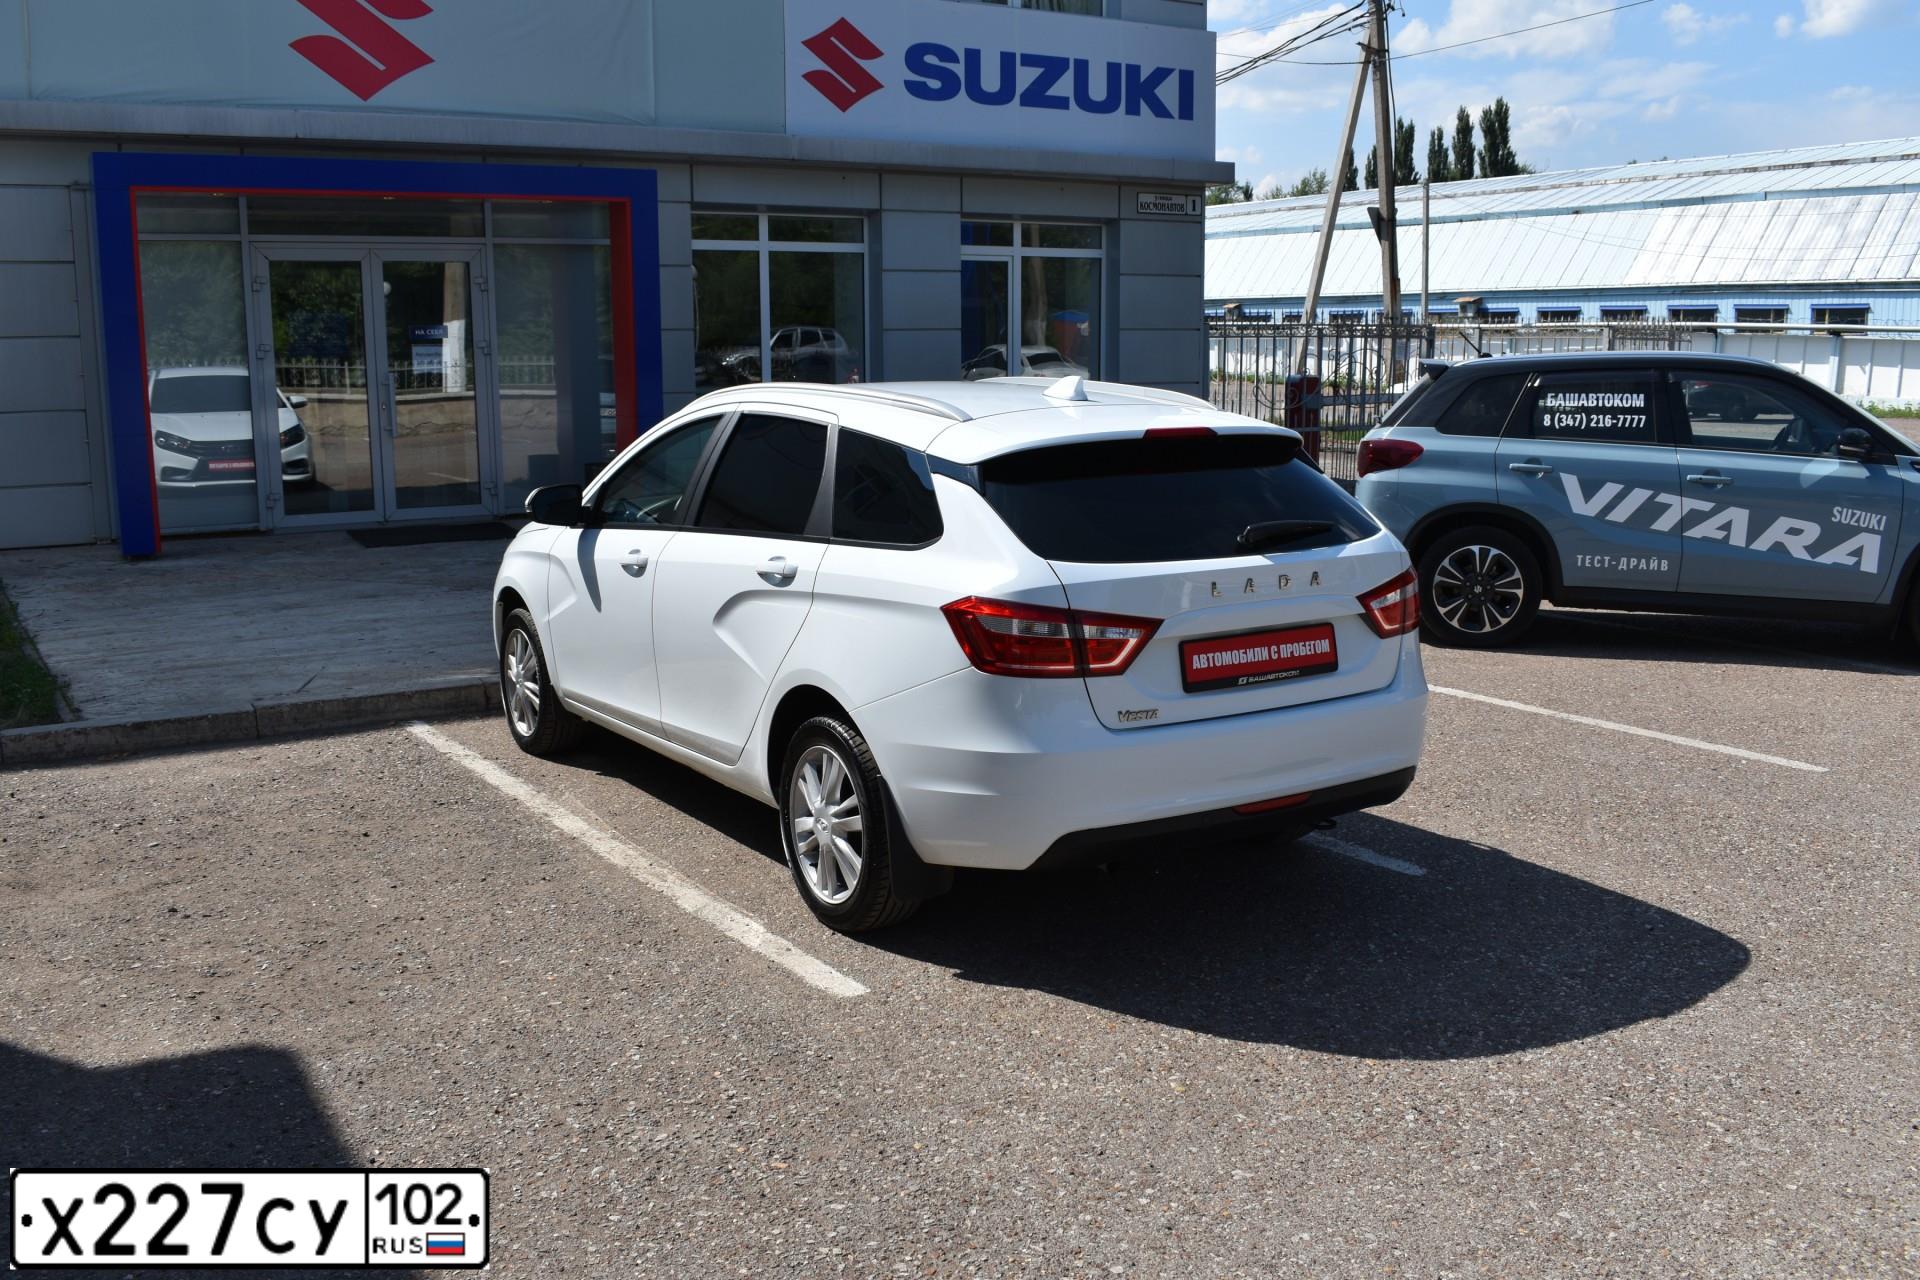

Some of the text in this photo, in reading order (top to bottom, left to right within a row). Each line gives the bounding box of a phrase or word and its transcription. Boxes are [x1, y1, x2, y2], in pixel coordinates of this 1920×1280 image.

[903, 42, 1195, 121] SUZUKI
[1192, 200, 1196, 211] 1
[1546, 393, 1645, 408] БАШАВТОКОМ
[1543, 412, 1647, 429] 8 (347) 216-7777
[1559, 472, 1882, 574] VITARA
[1831, 506, 1887, 531] SUZUKI
[1576, 554, 1669, 571] ТЕСТ-ДРАЙВ
[1210, 571, 1322, 598] LADA
[1192, 638, 1331, 670] АВТОМОБИЛИ С ПРОБЕГОМ
